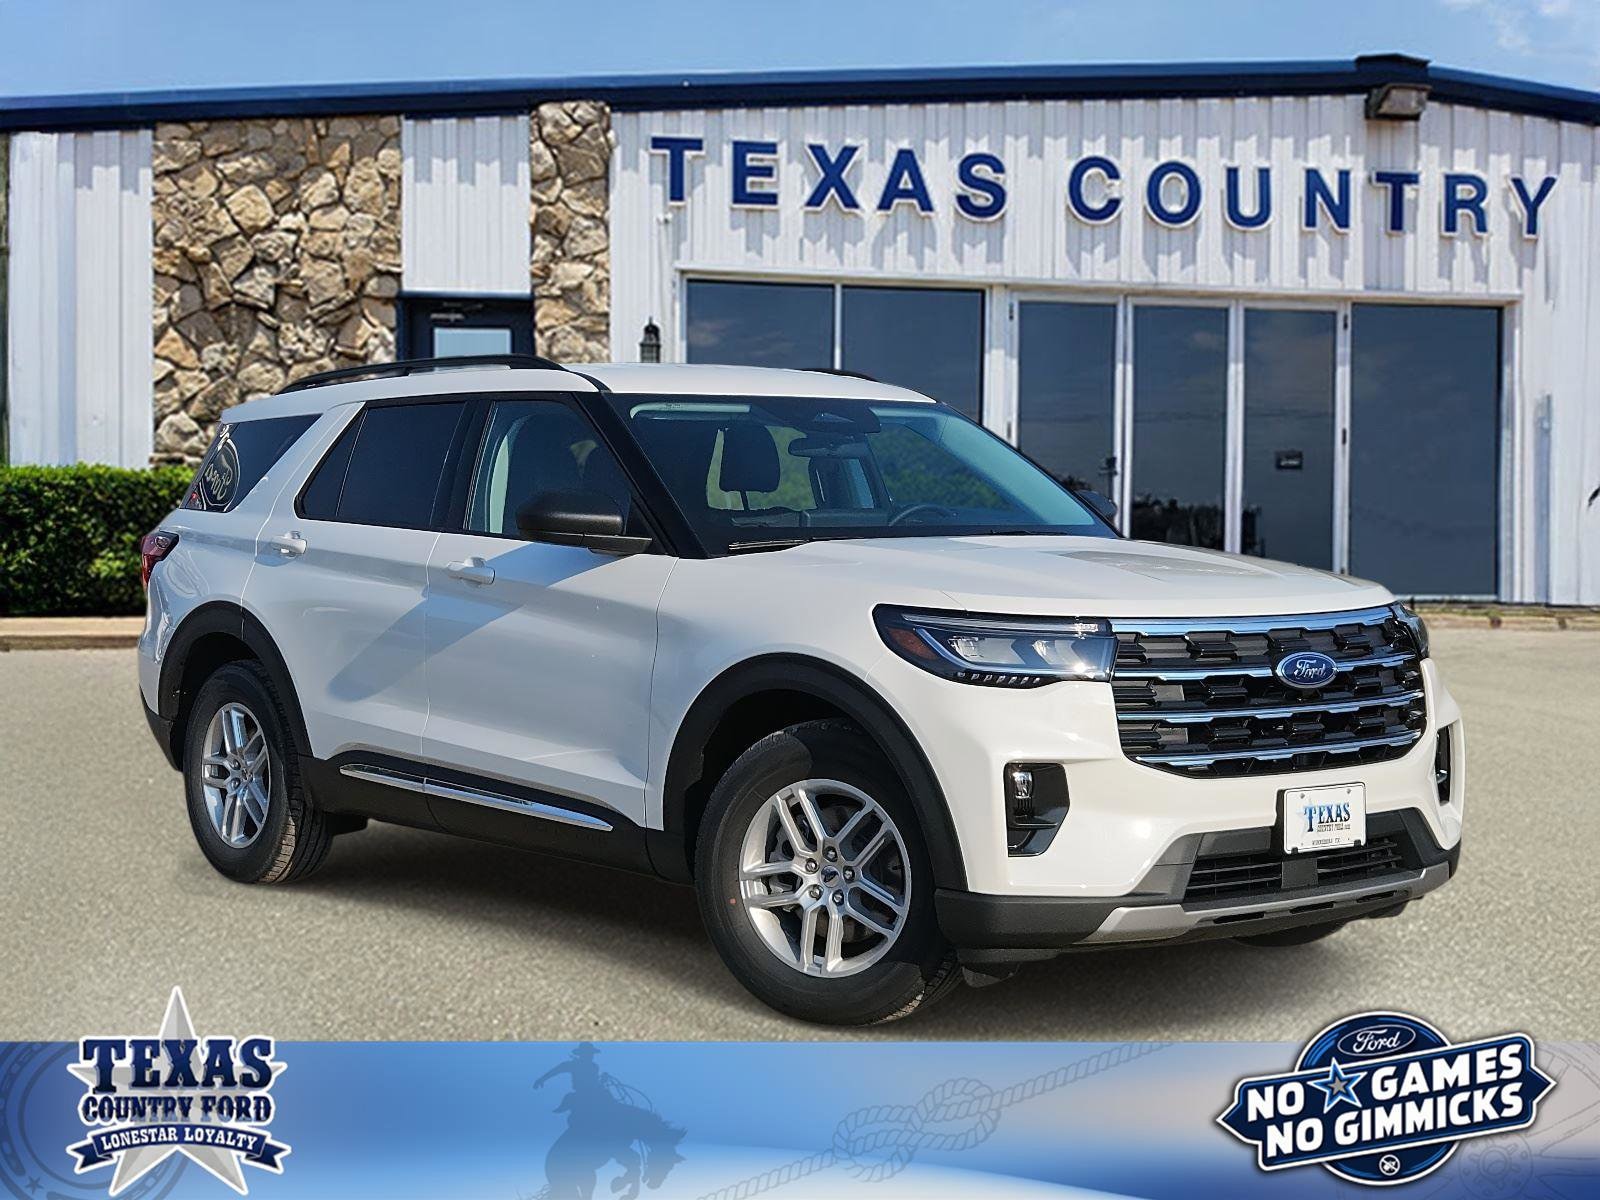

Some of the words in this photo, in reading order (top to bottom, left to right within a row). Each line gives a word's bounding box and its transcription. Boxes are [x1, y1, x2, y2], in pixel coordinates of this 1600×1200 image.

[651, 135, 1007, 222] TEXAS
[1068, 153, 1558, 240] COUNTRY
[1293, 659, 1327, 680] Ford
[1303, 802, 1351, 833] TEXAS
